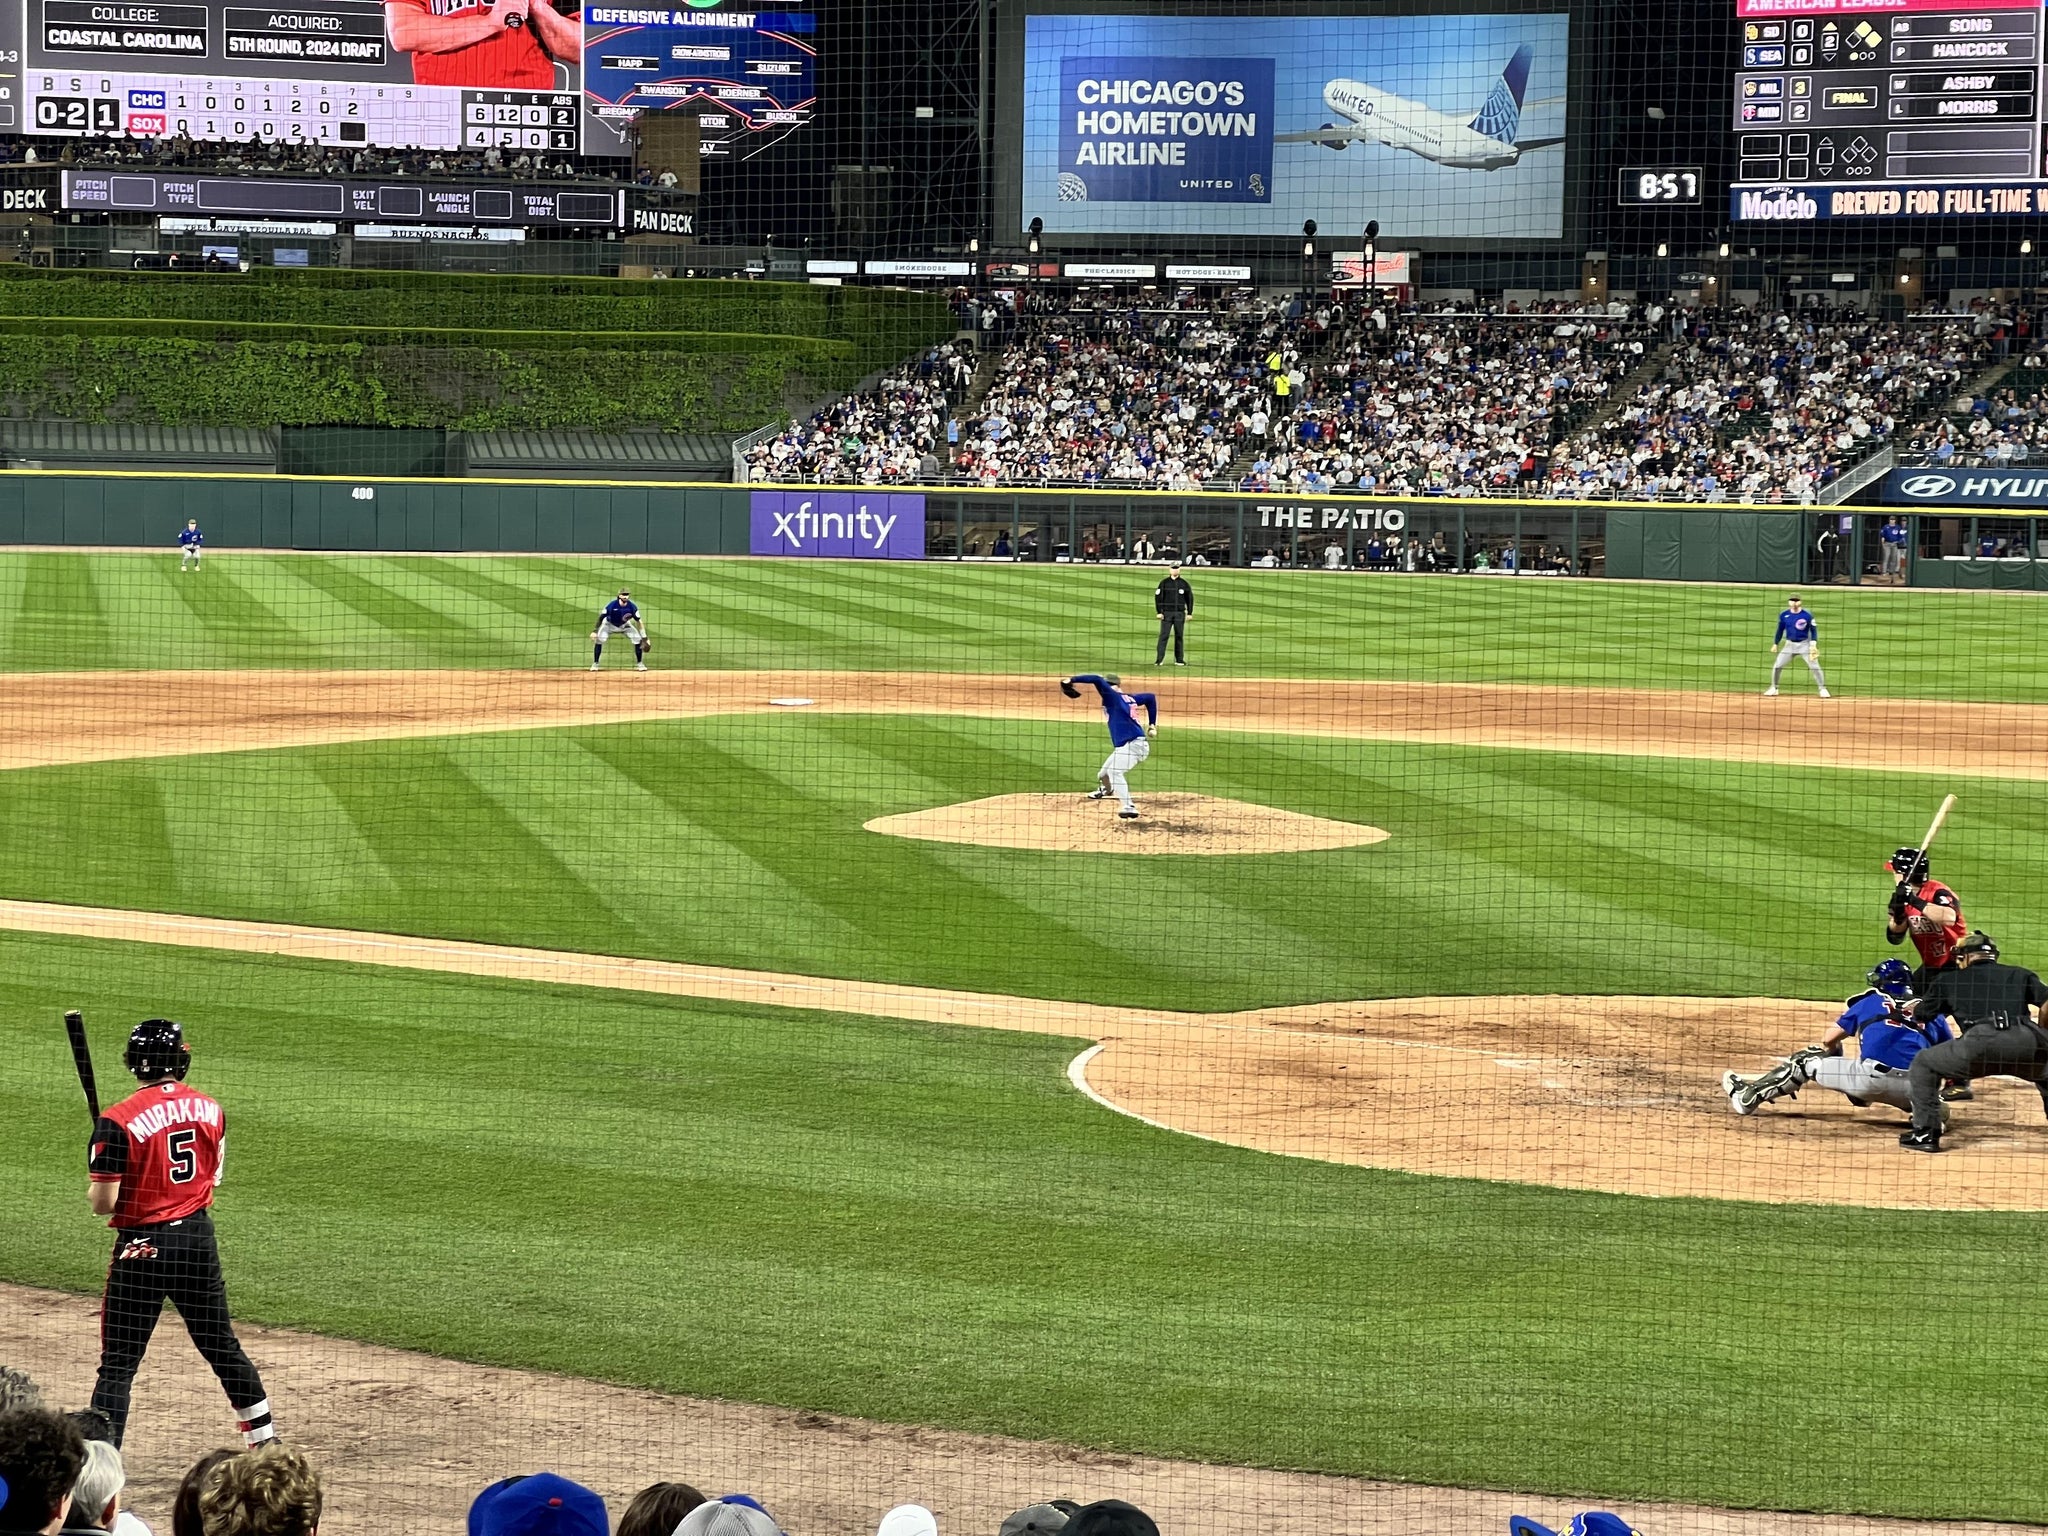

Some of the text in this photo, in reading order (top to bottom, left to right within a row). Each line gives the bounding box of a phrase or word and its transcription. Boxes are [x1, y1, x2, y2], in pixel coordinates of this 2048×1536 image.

[92, 7, 159, 22] COLLEGE:
[592, 9, 756, 28] DEFENSIVE ALIGNMENT
[268, 15, 343, 31] ACQUIRED:
[1949, 18, 1992, 33] SONG
[1763, 26, 1780, 38] SD
[1796, 24, 1809, 38] 0
[49, 29, 204, 50] COASTAL CAROLINA
[1824, 36, 1835, 48] 2
[229, 37, 382, 58] 5TH ROUND, 2024 DRAFT
[1760, 50, 1782, 61] SEA
[1796, 48, 1808, 62] 0
[1933, 42, 2008, 58] HANCOCK
[618, 59, 643, 68] HAPP
[757, 64, 790, 73] SUZUKI
[44, 77, 53, 90] B
[71, 78, 81, 91] S
[1759, 81, 1806, 95] MIL 3
[1942, 75, 1995, 90] ASHBY
[178, 80, 572, 105] 1 2 3 4 5 6 7 8 9 R H E ABS
[641, 86, 686, 95] SWANSON
[718, 88, 760, 98] HOERNER
[1077, 79, 1245, 106] CHICAGO'S
[1832, 92, 1869, 104] FINAL
[131, 93, 569, 123] CHC 1 0 0 1 2 0 2 6 12 0 2
[1332, 87, 1374, 116] UNITED
[1938, 99, 1998, 115] MORRIS
[38, 101, 114, 127] 0-2 1
[766, 112, 797, 121] BUSCH
[1757, 106, 1780, 118] MIN
[1793, 105, 1806, 118] 2
[1077, 110, 1256, 137] HOMETOWN
[132, 117, 568, 147] SOX 0 1 0 0 2 1 4 5 0 1
[1076, 141, 1186, 166] AIRLINE
[76, 180, 107, 190] PITCH
[163, 183, 194, 193] PITCH
[1180, 180, 1233, 189] UNITED
[1640, 173, 1696, 199] 8:57
[3, 189, 46, 210] DECK
[72, 191, 107, 201] SPEED
[167, 194, 194, 204] TYPE
[353, 190, 375, 200] EXIT
[429, 193, 470, 203] LAUNCH
[523, 196, 555, 206] TOTAL
[1832, 191, 1901, 215] BREWED
[1906, 190, 1939, 214] FOR
[1944, 189, 2032, 214] FULL-TIME
[436, 204, 470, 214] ANGLE
[1740, 191, 1818, 220] Modelo
[634, 210, 693, 233] FAN DECK
[250, 226, 290, 234] TEQUILA
[391, 230, 439, 239] BUENOS
[352, 487, 373, 500] 400
[772, 501, 897, 549] xfinity
[1257, 506, 1405, 531] THE PATIO
[168, 1128, 196, 1184] 5
